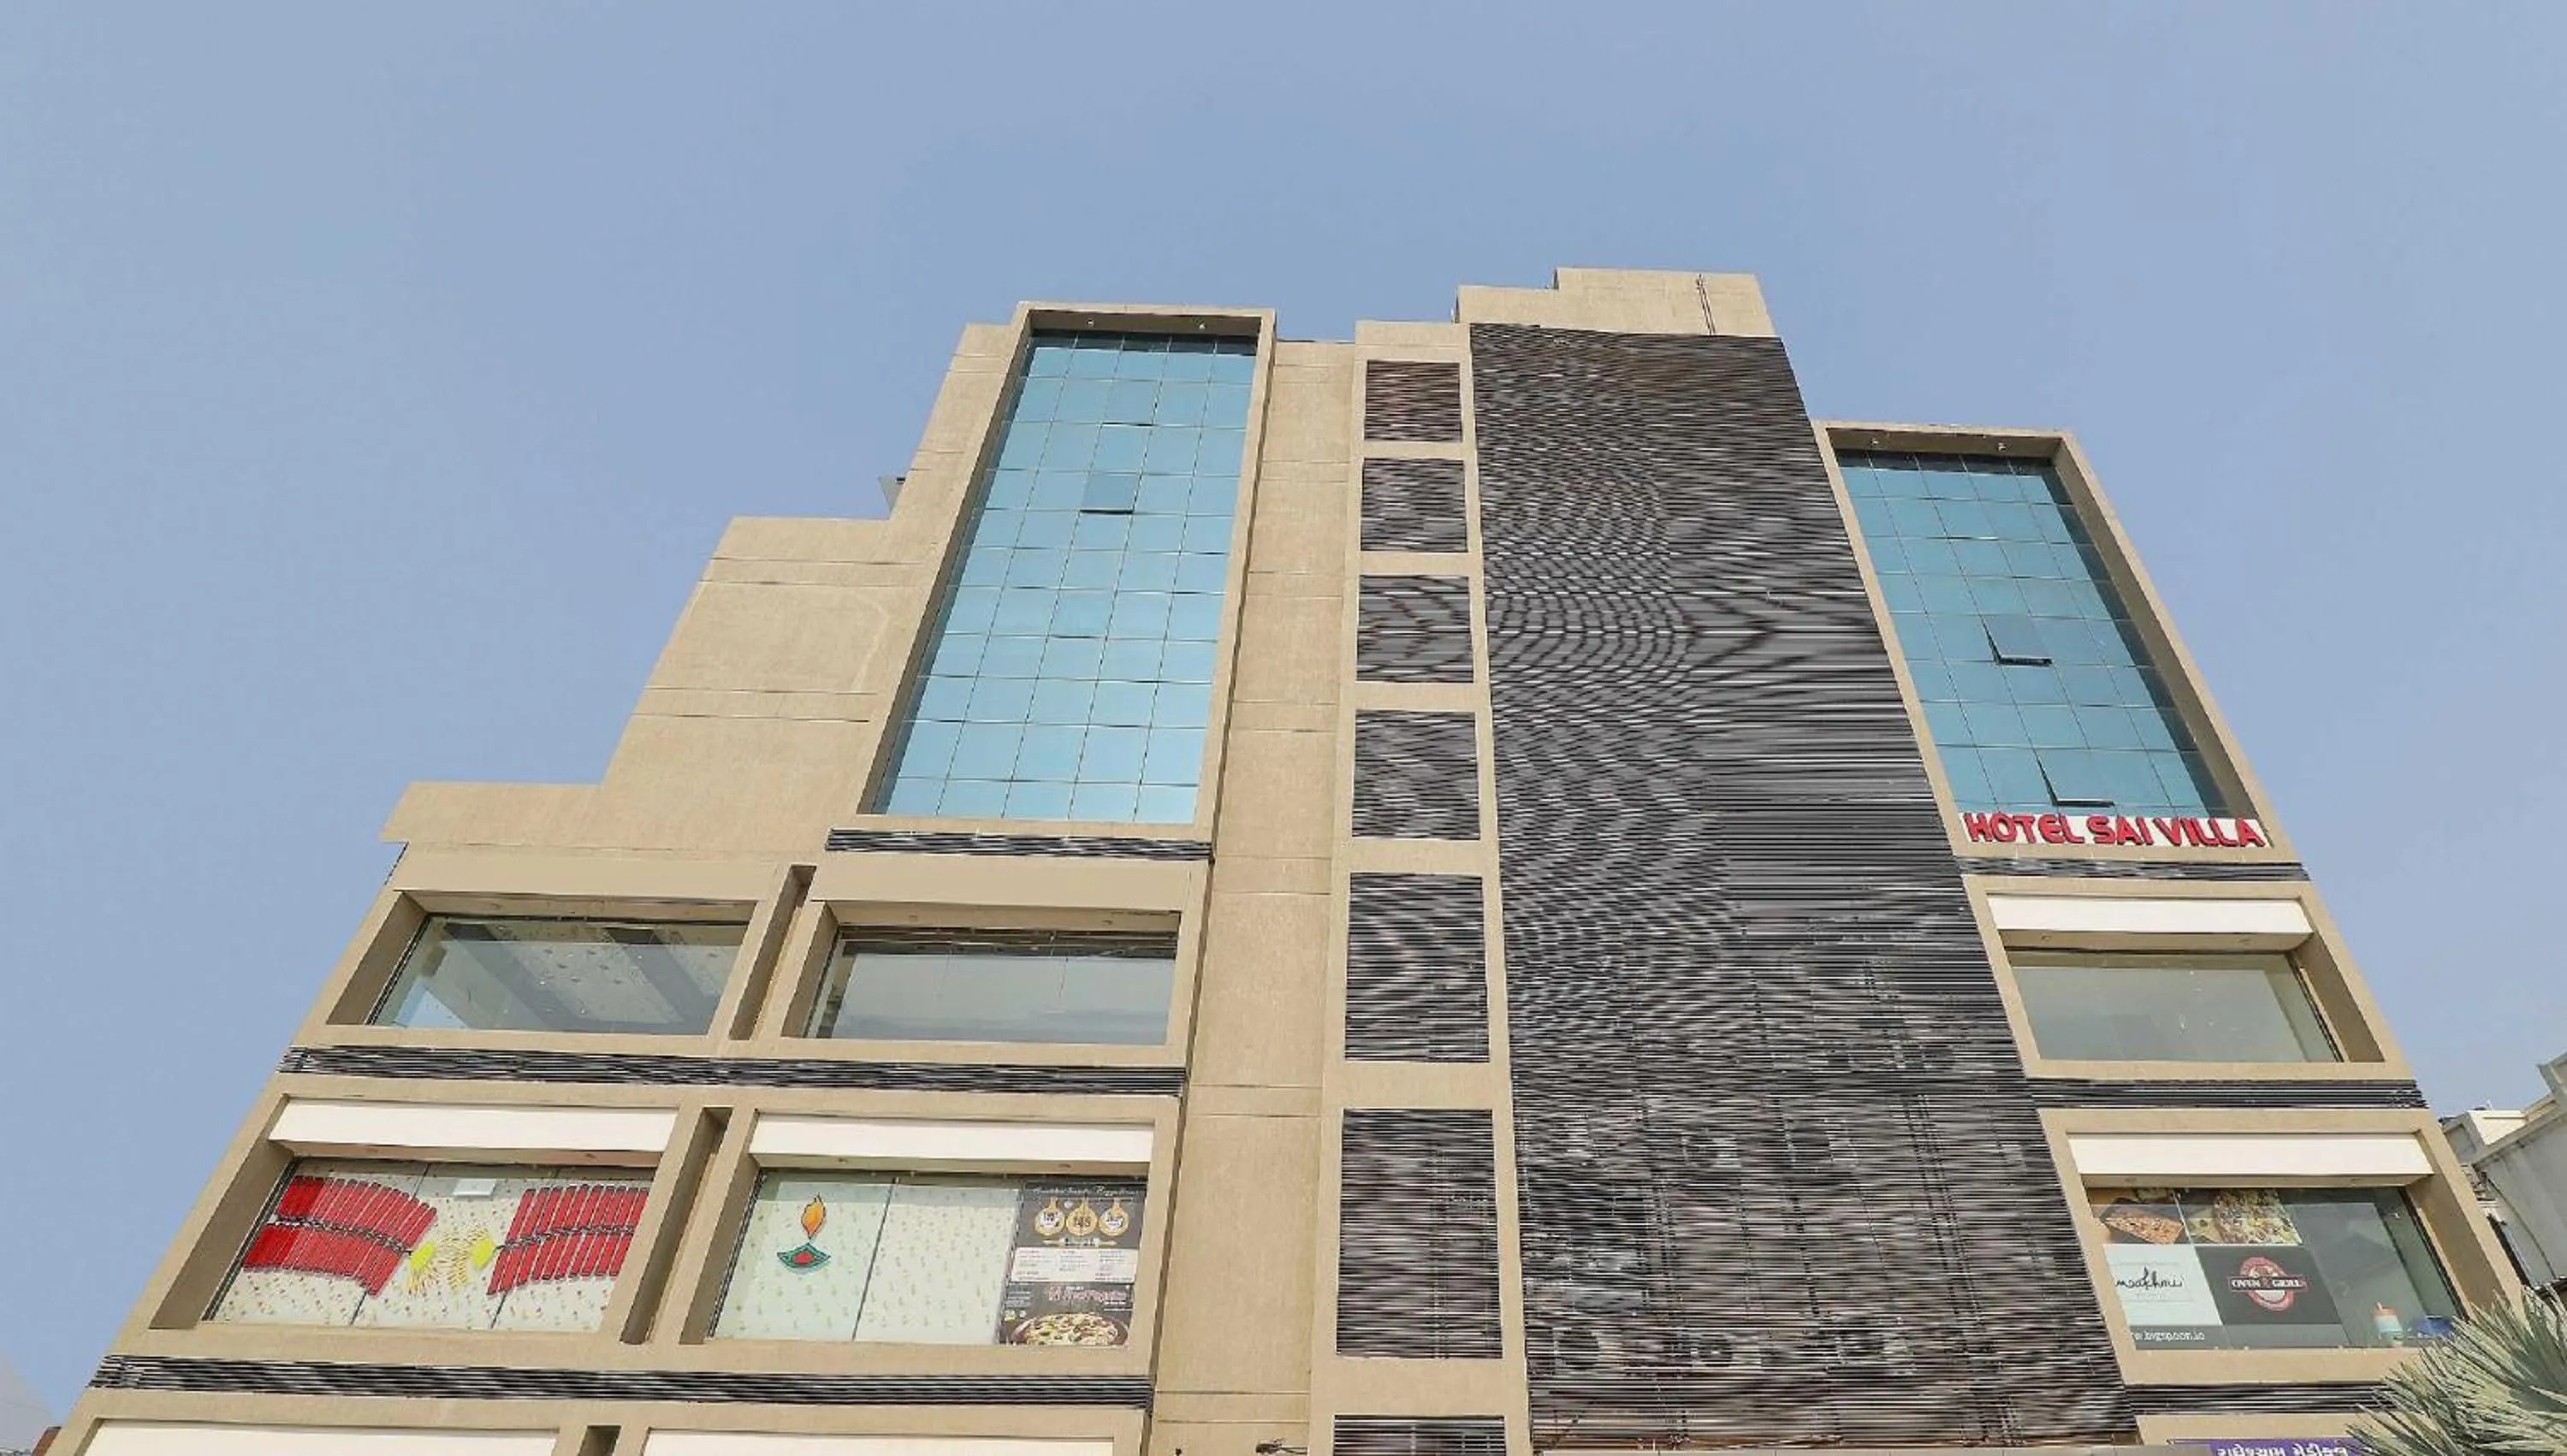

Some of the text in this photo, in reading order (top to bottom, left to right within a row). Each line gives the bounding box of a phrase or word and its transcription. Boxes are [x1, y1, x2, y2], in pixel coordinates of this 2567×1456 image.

[1964, 812, 2266, 848] HOTEL SAI VILLA
